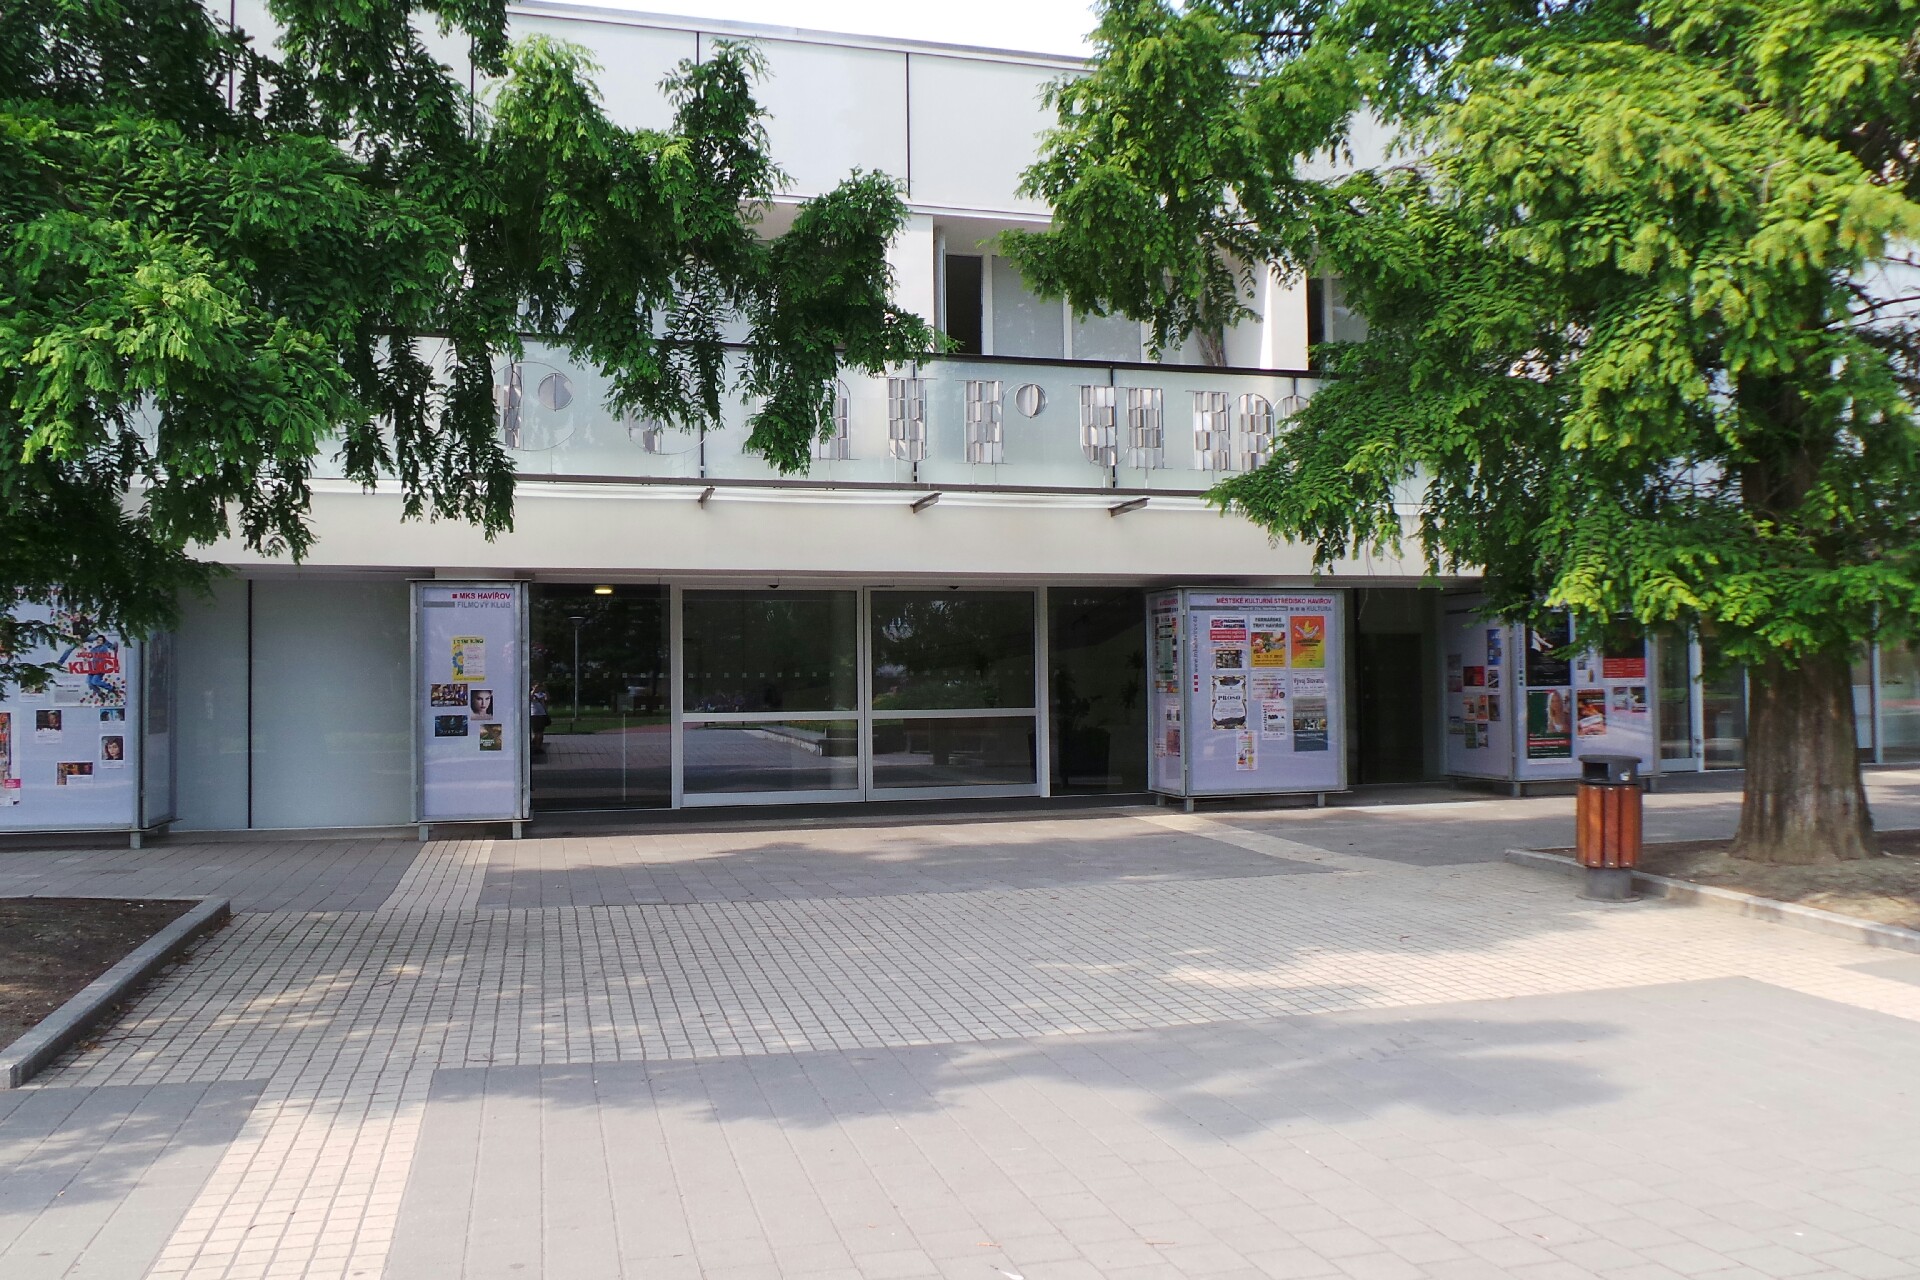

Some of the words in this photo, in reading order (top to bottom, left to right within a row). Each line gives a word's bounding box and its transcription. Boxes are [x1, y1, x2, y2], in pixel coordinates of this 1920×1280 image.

[459, 592, 476, 600] MKS
[477, 591, 511, 600] HAVÍŘOV
[457, 600, 489, 609] FILMOVÝ
[490, 601, 511, 609] KLUB
